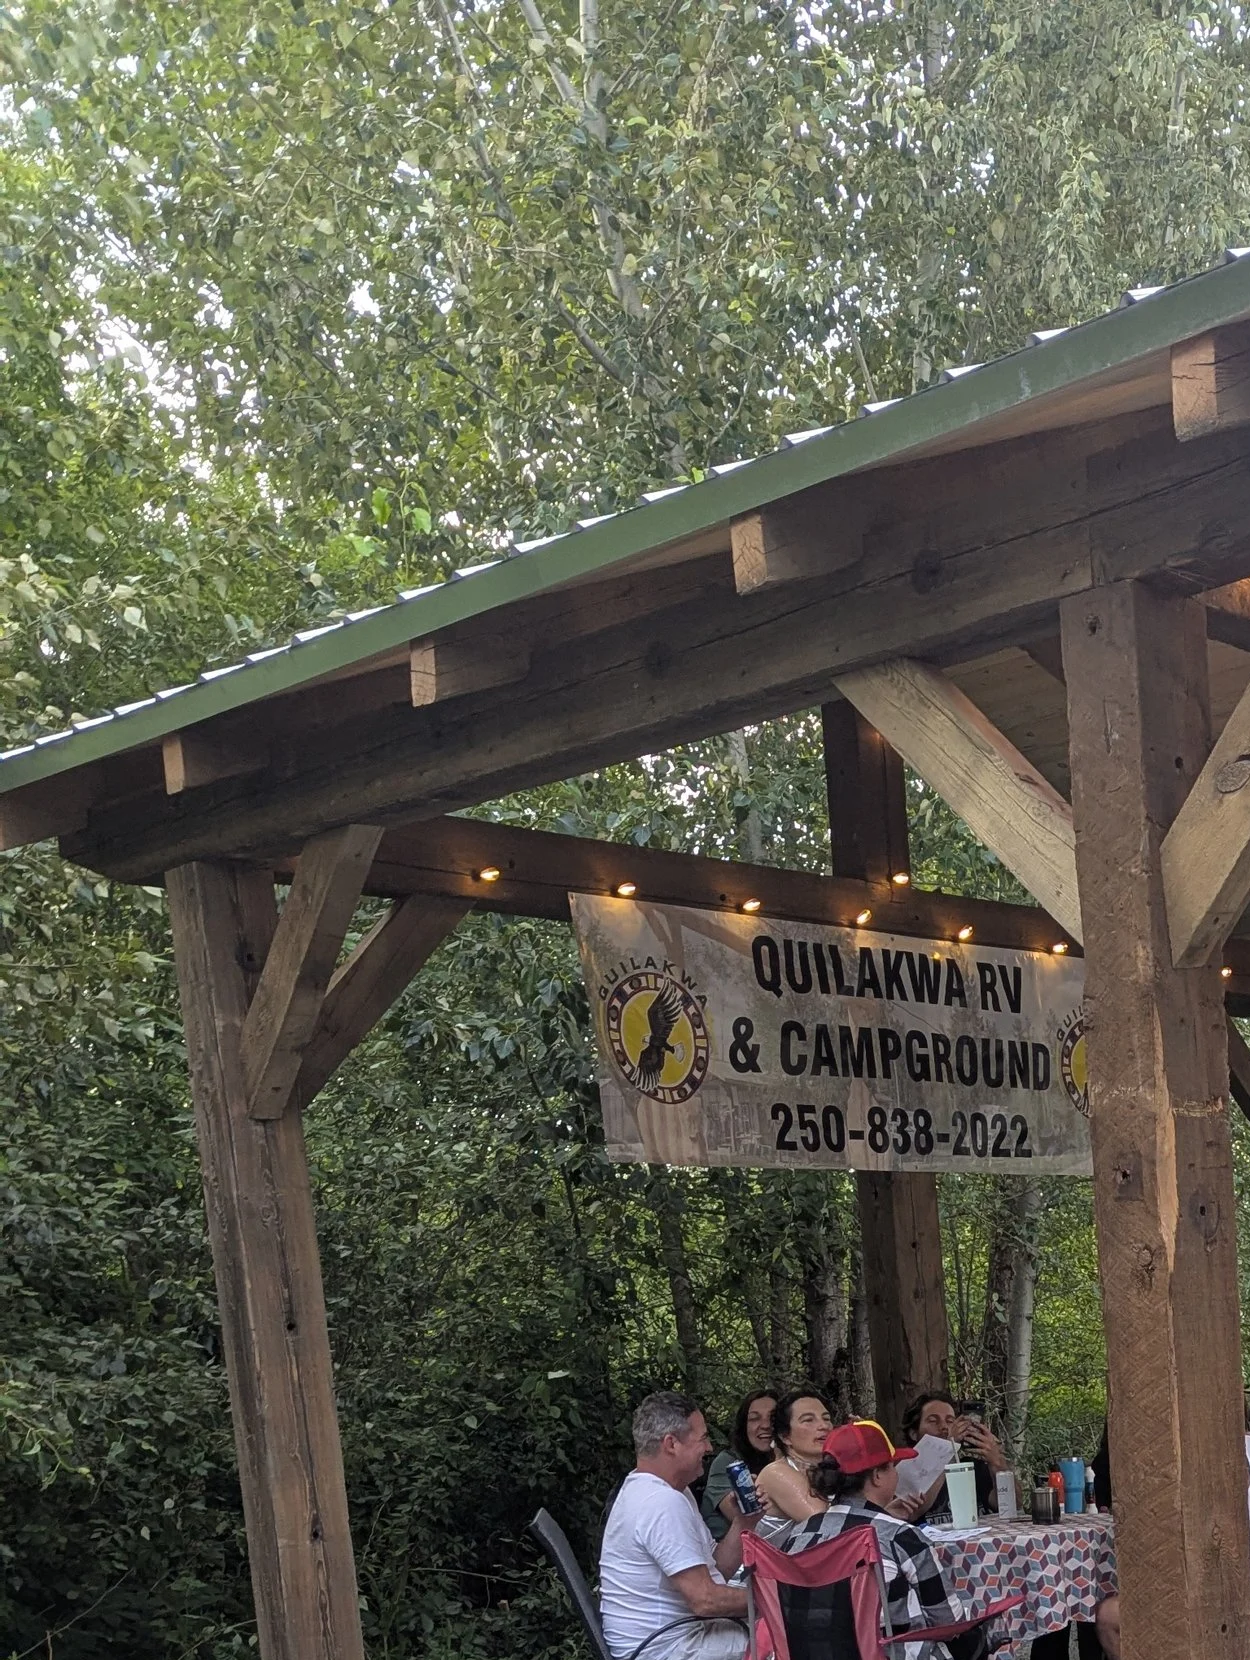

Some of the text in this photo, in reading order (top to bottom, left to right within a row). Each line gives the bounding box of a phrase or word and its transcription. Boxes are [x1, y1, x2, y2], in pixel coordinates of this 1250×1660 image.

[599, 956, 708, 1010] QUILAKWA
[751, 935, 1022, 1014] QUILAKWA RV
[1056, 1005, 1084, 1041] QUIL
[728, 1016, 1051, 1091] & CAMPGROUND
[770, 1102, 1033, 1158] 250-838-2022
